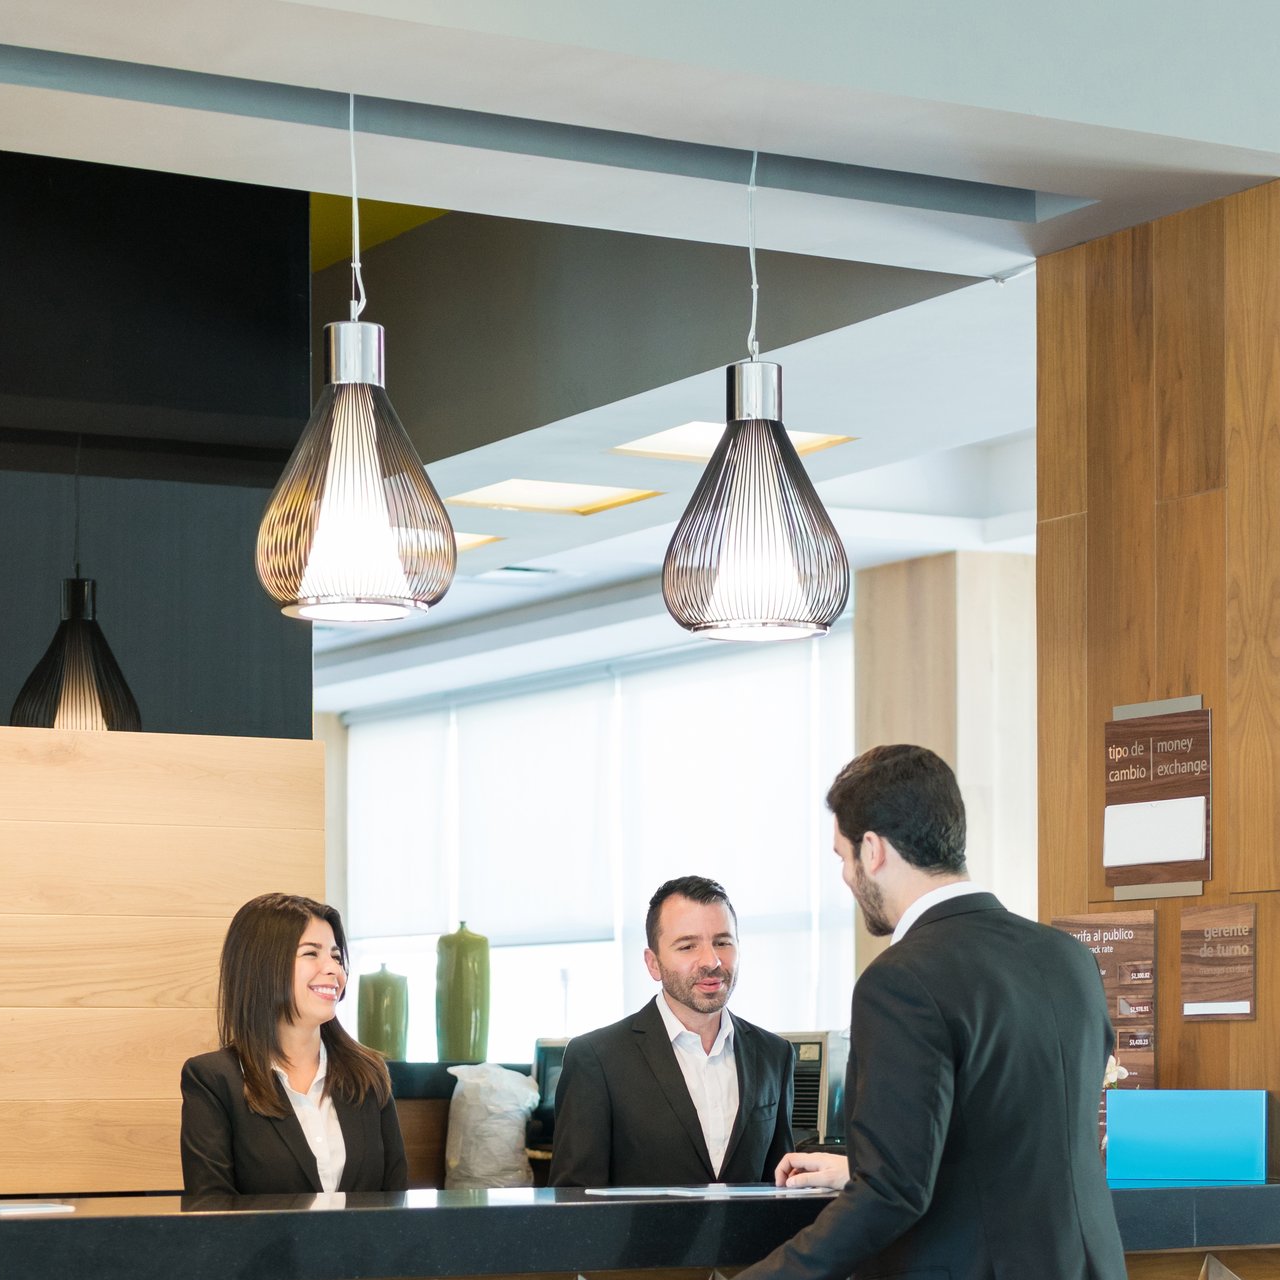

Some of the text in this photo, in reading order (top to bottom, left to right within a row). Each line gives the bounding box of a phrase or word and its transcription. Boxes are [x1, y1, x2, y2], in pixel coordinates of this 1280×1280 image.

[1108, 741, 1145, 762] tipo de
[1157, 737, 1193, 753] money
[1108, 764, 1147, 782] cambio
[1157, 758, 1208, 776] exchange
[1093, 930, 1100, 941] al
[1103, 928, 1134, 943] publico
[1204, 925, 1249, 942] gerente
[1200, 943, 1249, 957] de turno
